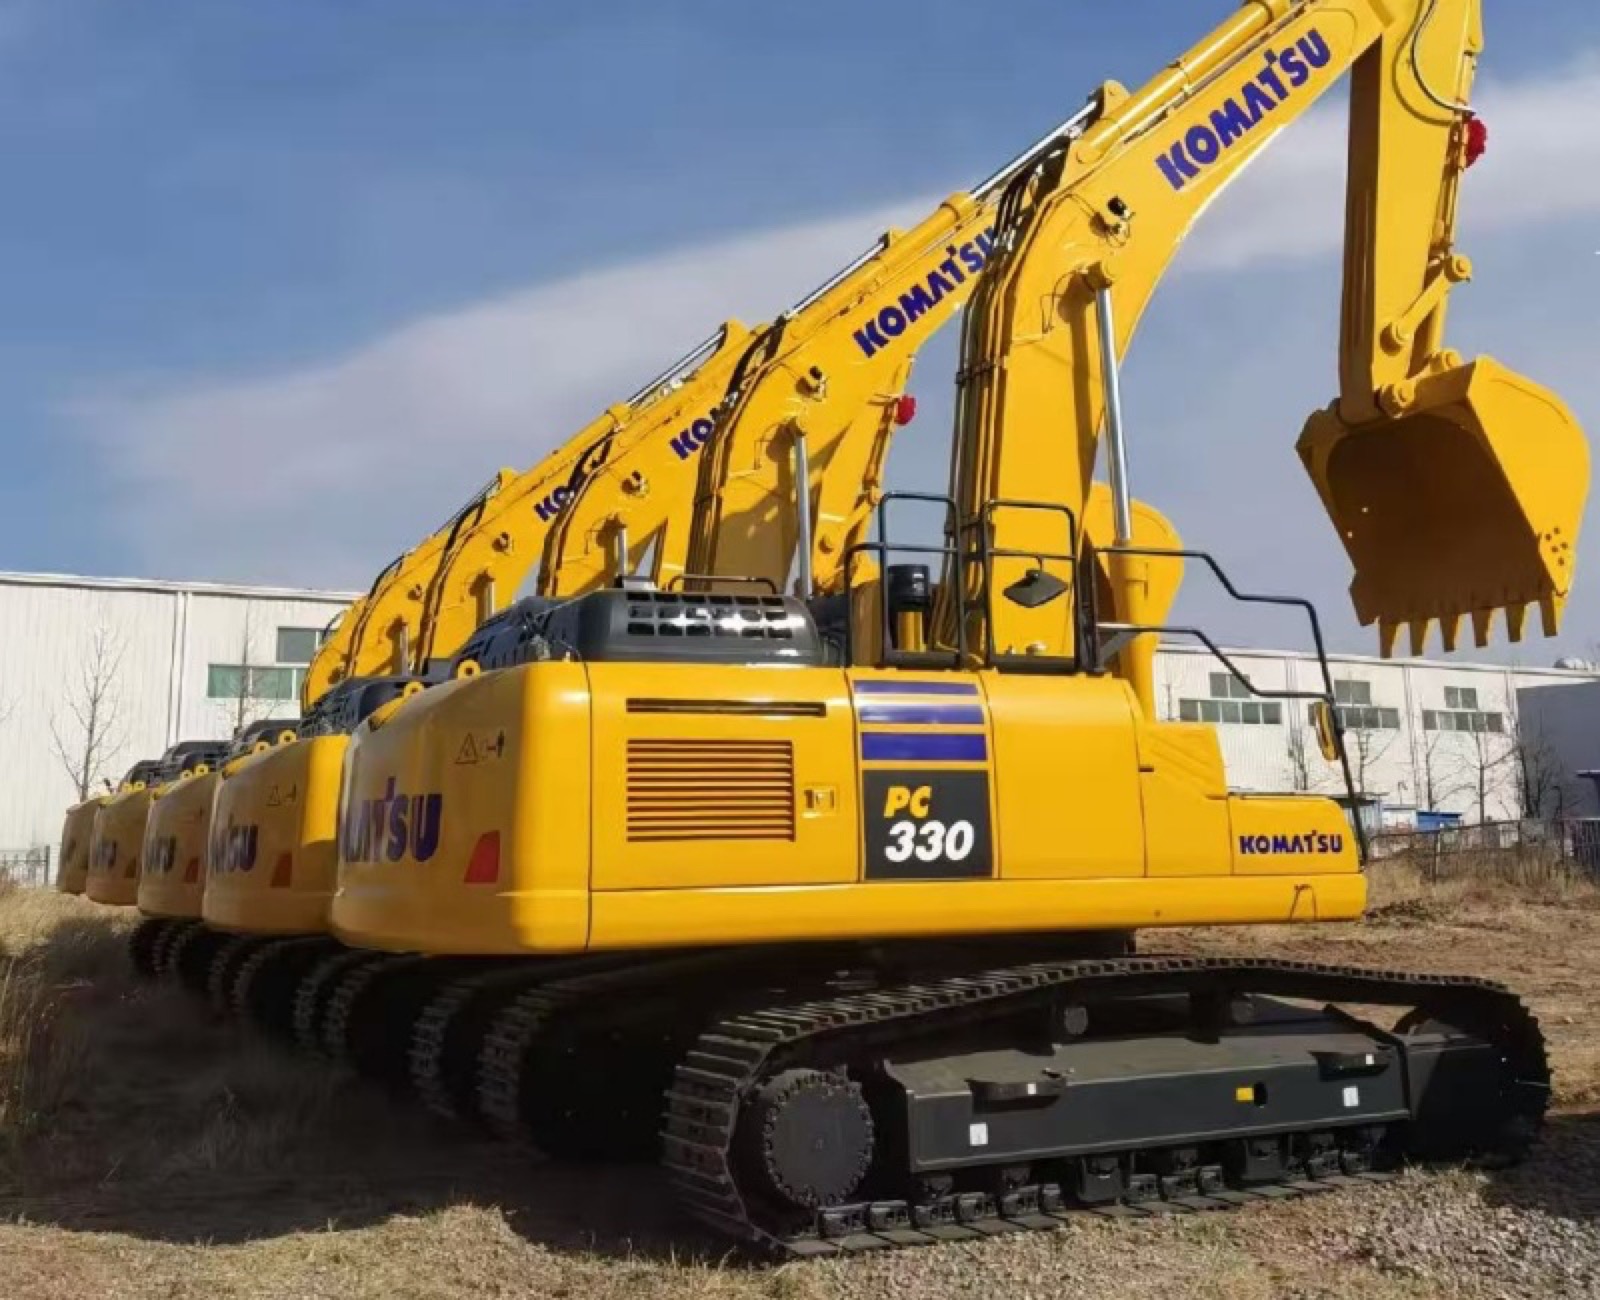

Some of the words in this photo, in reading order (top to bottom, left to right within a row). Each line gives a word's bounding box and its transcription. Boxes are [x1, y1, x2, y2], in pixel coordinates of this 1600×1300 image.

[1155, 29, 1331, 190] KOMATSU
[884, 786, 932, 819] PC
[885, 820, 974, 862] 330
[1239, 829, 1342, 855] KOMATSU
